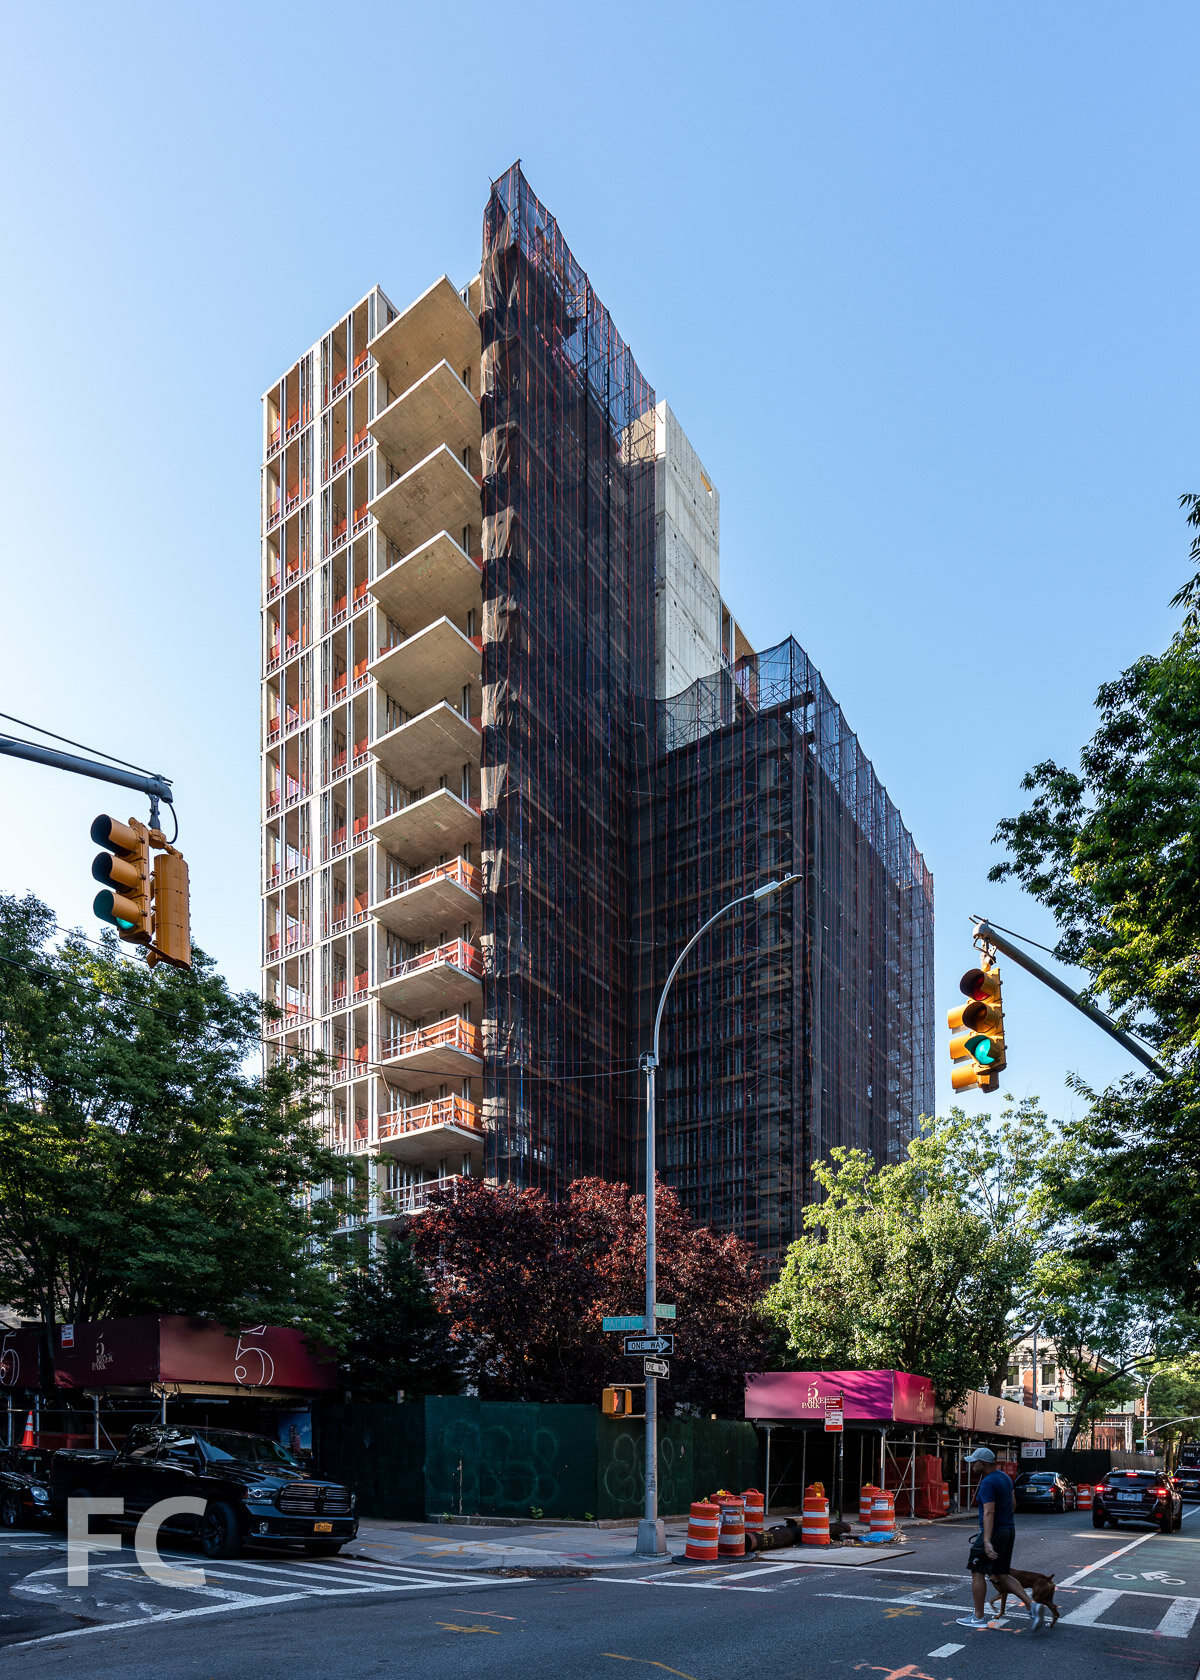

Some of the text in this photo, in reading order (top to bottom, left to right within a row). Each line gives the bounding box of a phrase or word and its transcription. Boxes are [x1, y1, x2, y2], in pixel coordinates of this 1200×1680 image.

[604, 1318, 637, 1329] PACIFIC
[647, 1362, 655, 1370] ONE
[807, 1380, 819, 1398] 5
